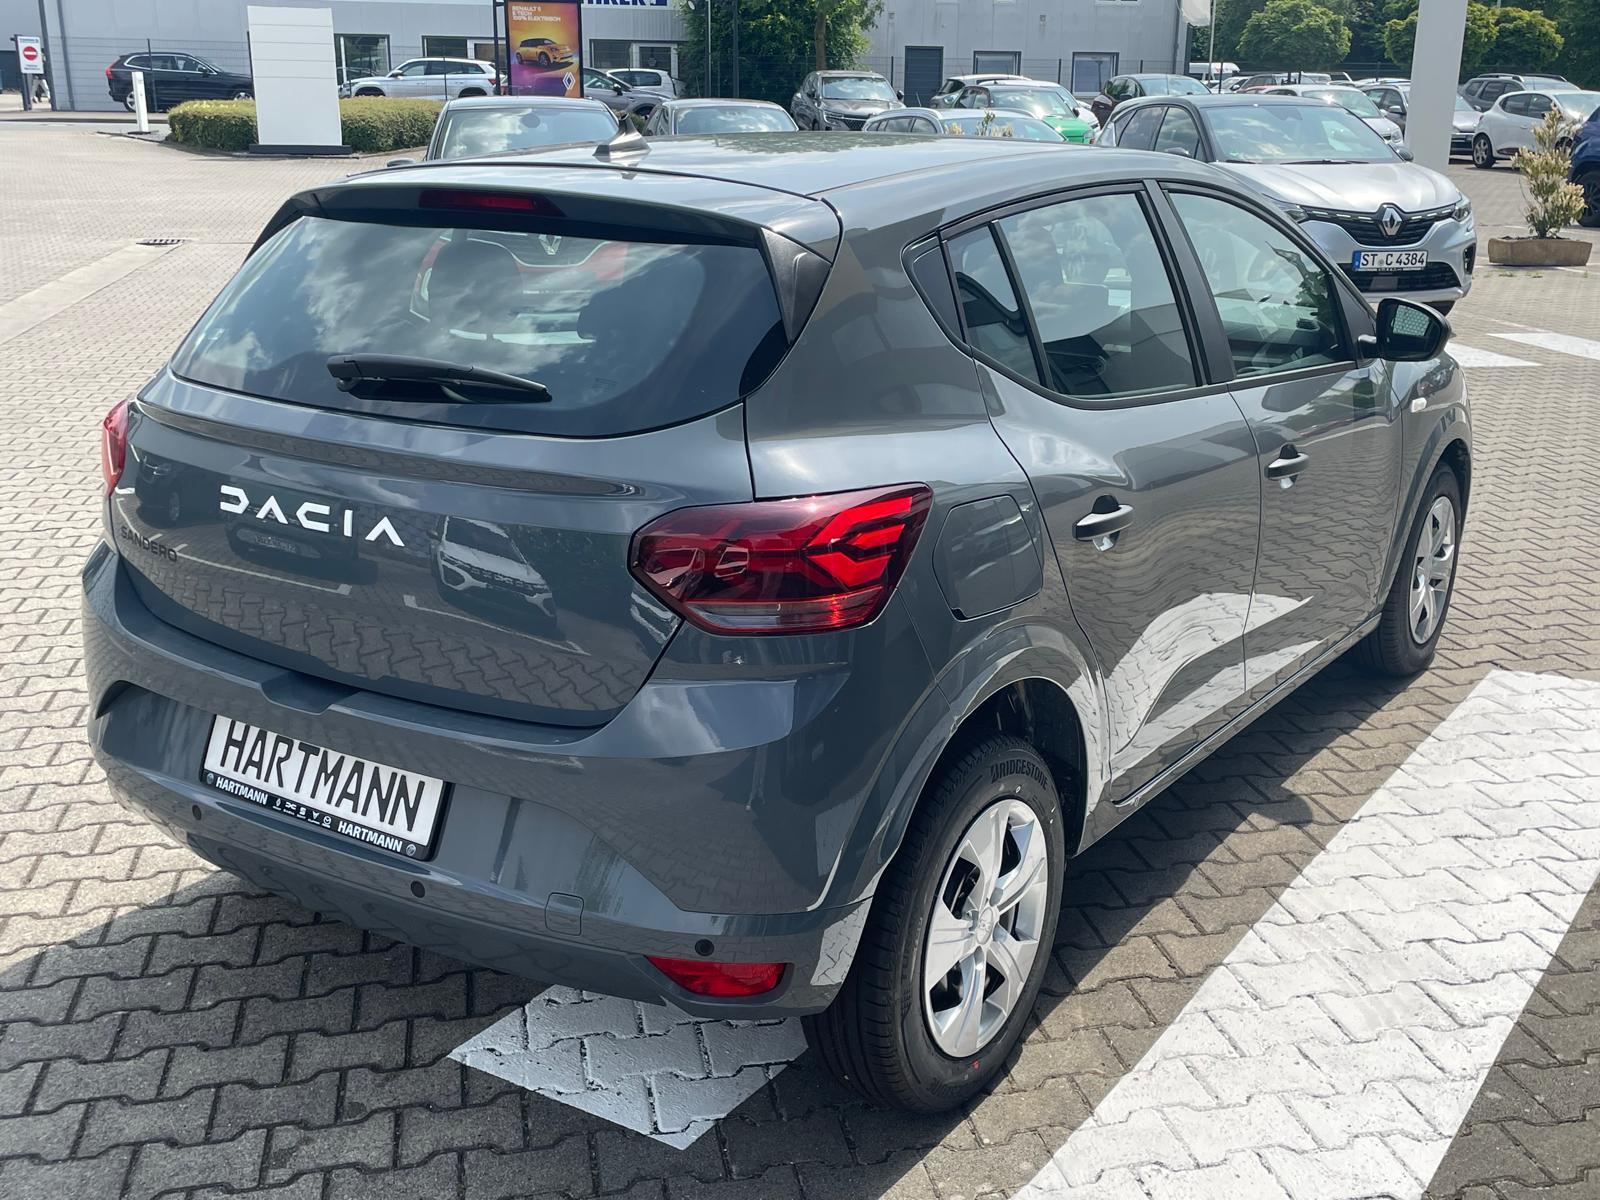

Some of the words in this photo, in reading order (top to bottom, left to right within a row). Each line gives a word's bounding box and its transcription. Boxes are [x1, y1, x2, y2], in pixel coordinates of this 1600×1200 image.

[1361, 253, 1378, 266] ST
[1386, 253, 1393, 266] C
[1396, 253, 1425, 266] 4384
[220, 485, 405, 547] DACIA
[121, 525, 177, 562] SANDERO
[220, 719, 425, 832] HARTMANN
[990, 759, 1048, 790] BRIDGESTONE
[215, 777, 268, 805] HARTMANN
[338, 821, 403, 853] HARTMANN
